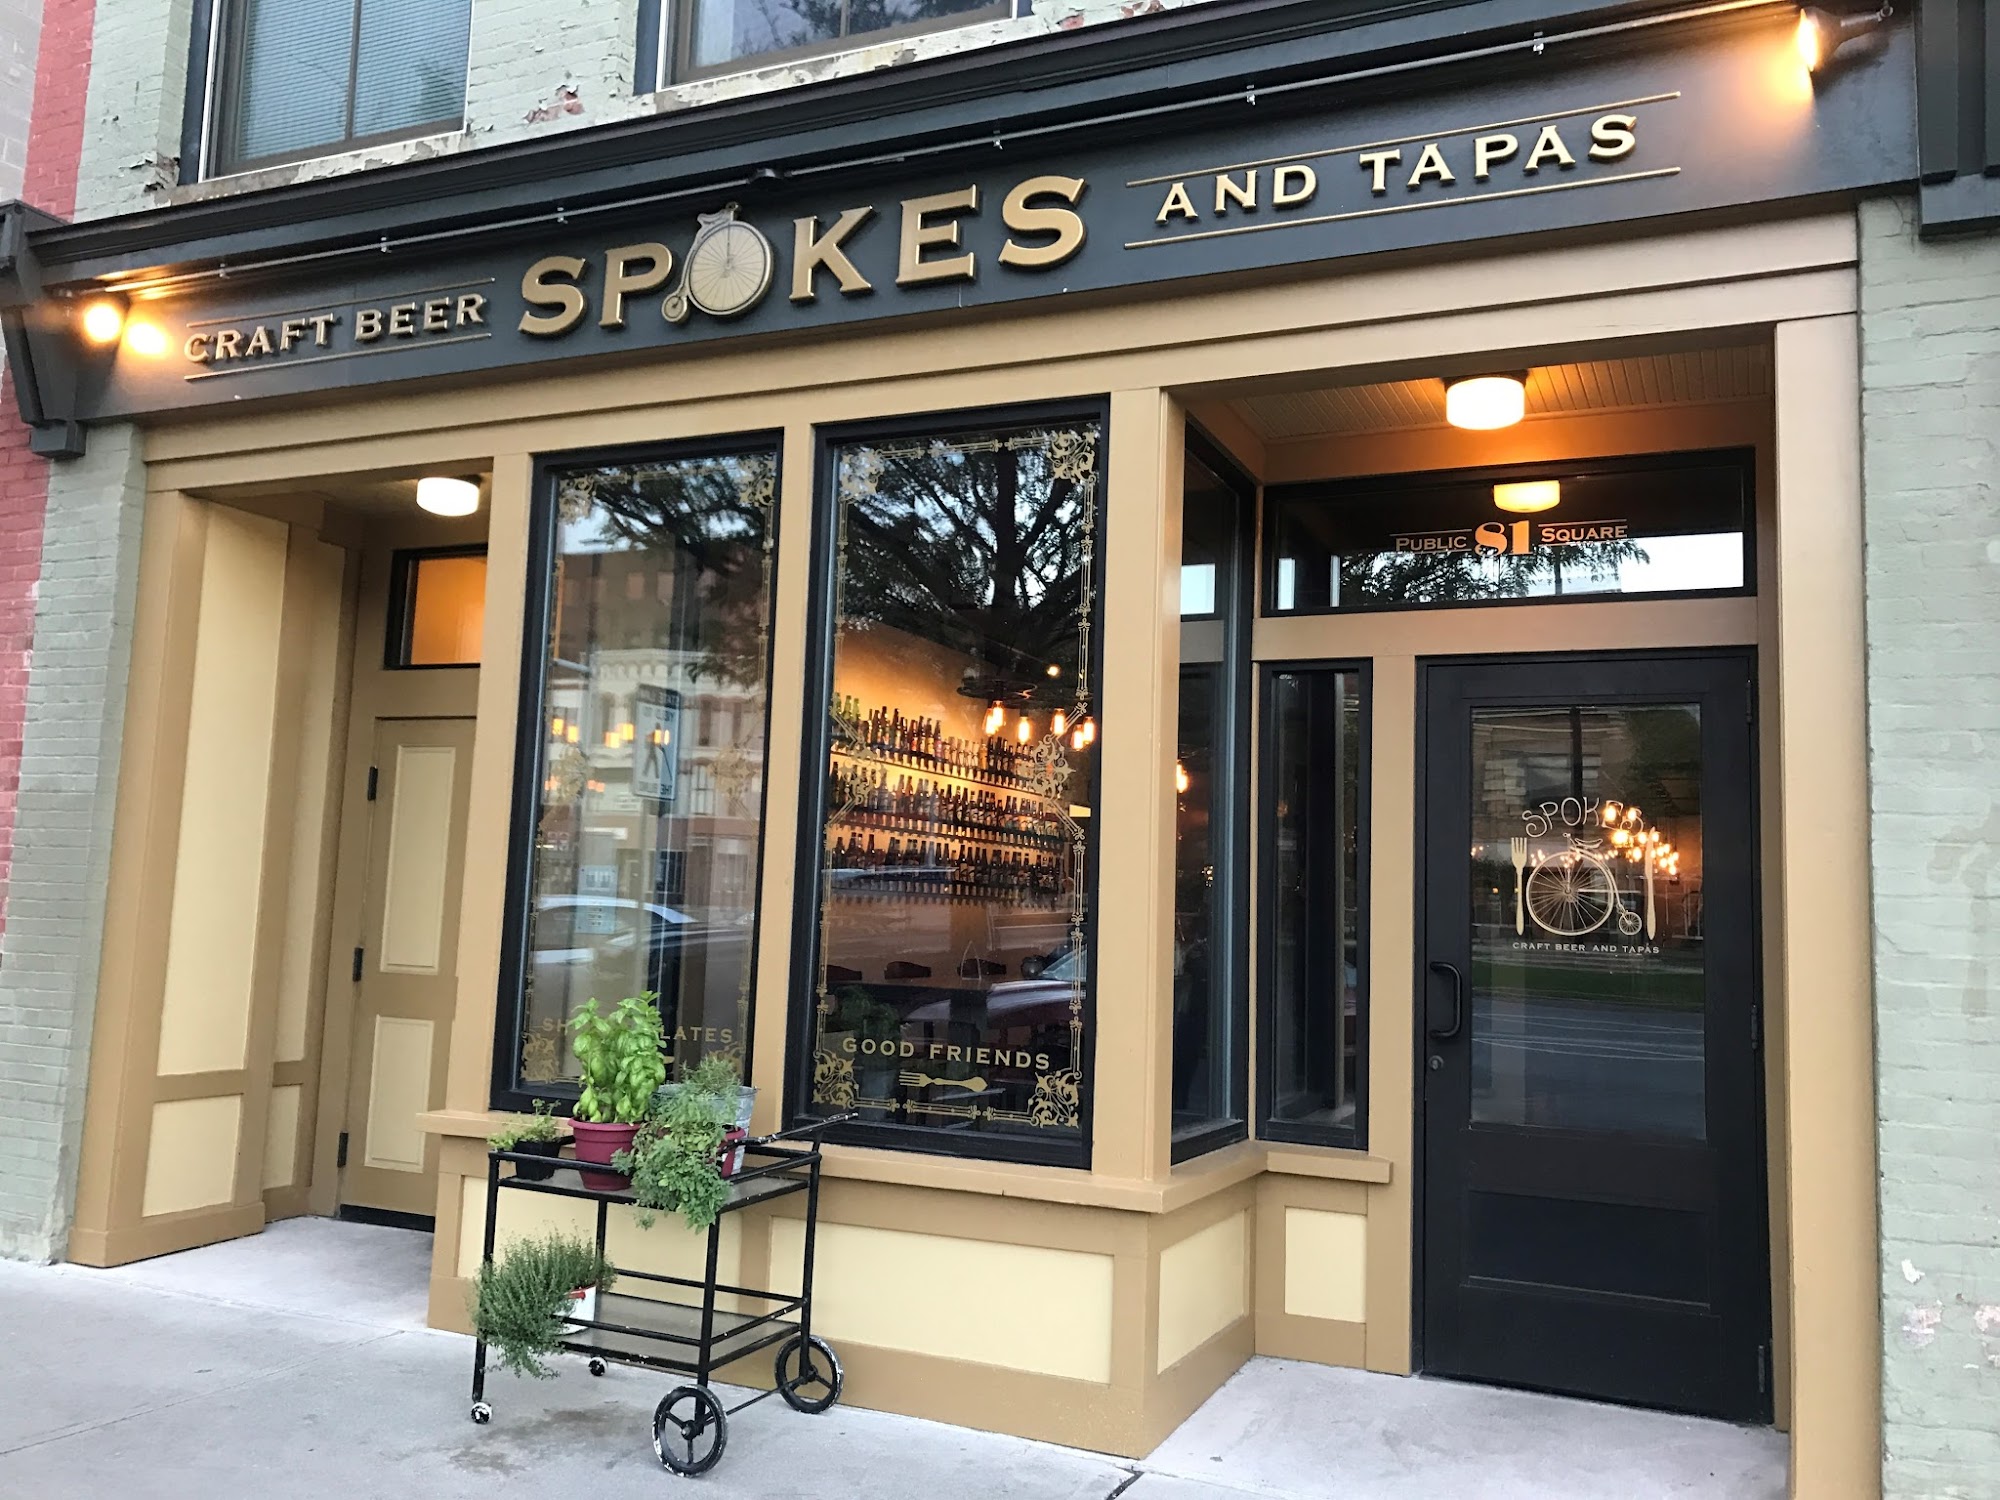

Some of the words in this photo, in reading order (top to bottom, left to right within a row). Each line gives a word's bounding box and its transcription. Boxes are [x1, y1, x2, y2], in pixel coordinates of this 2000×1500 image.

[1156, 166, 1317, 224] AND
[1359, 114, 1637, 194] TAPAS
[518, 175, 1087, 336] SPOKES
[184, 313, 334, 363] CRAFT
[355, 294, 487, 341] BEER
[1396, 533, 1467, 551] PUBLIC
[1474, 520, 1532, 557] 81
[1541, 525, 1628, 543] SQUARE
[1522, 797, 1644, 838] SPOKES
[1512, 942, 1551, 950] CRAFT
[1555, 943, 1585, 951] BEER
[1592, 945, 1618, 953] AND
[1622, 945, 1660, 954] TAPAS
[658, 1026, 732, 1043] LATES
[843, 1037, 915, 1058] GOOD
[929, 1044, 1049, 1069] FRIENDS
